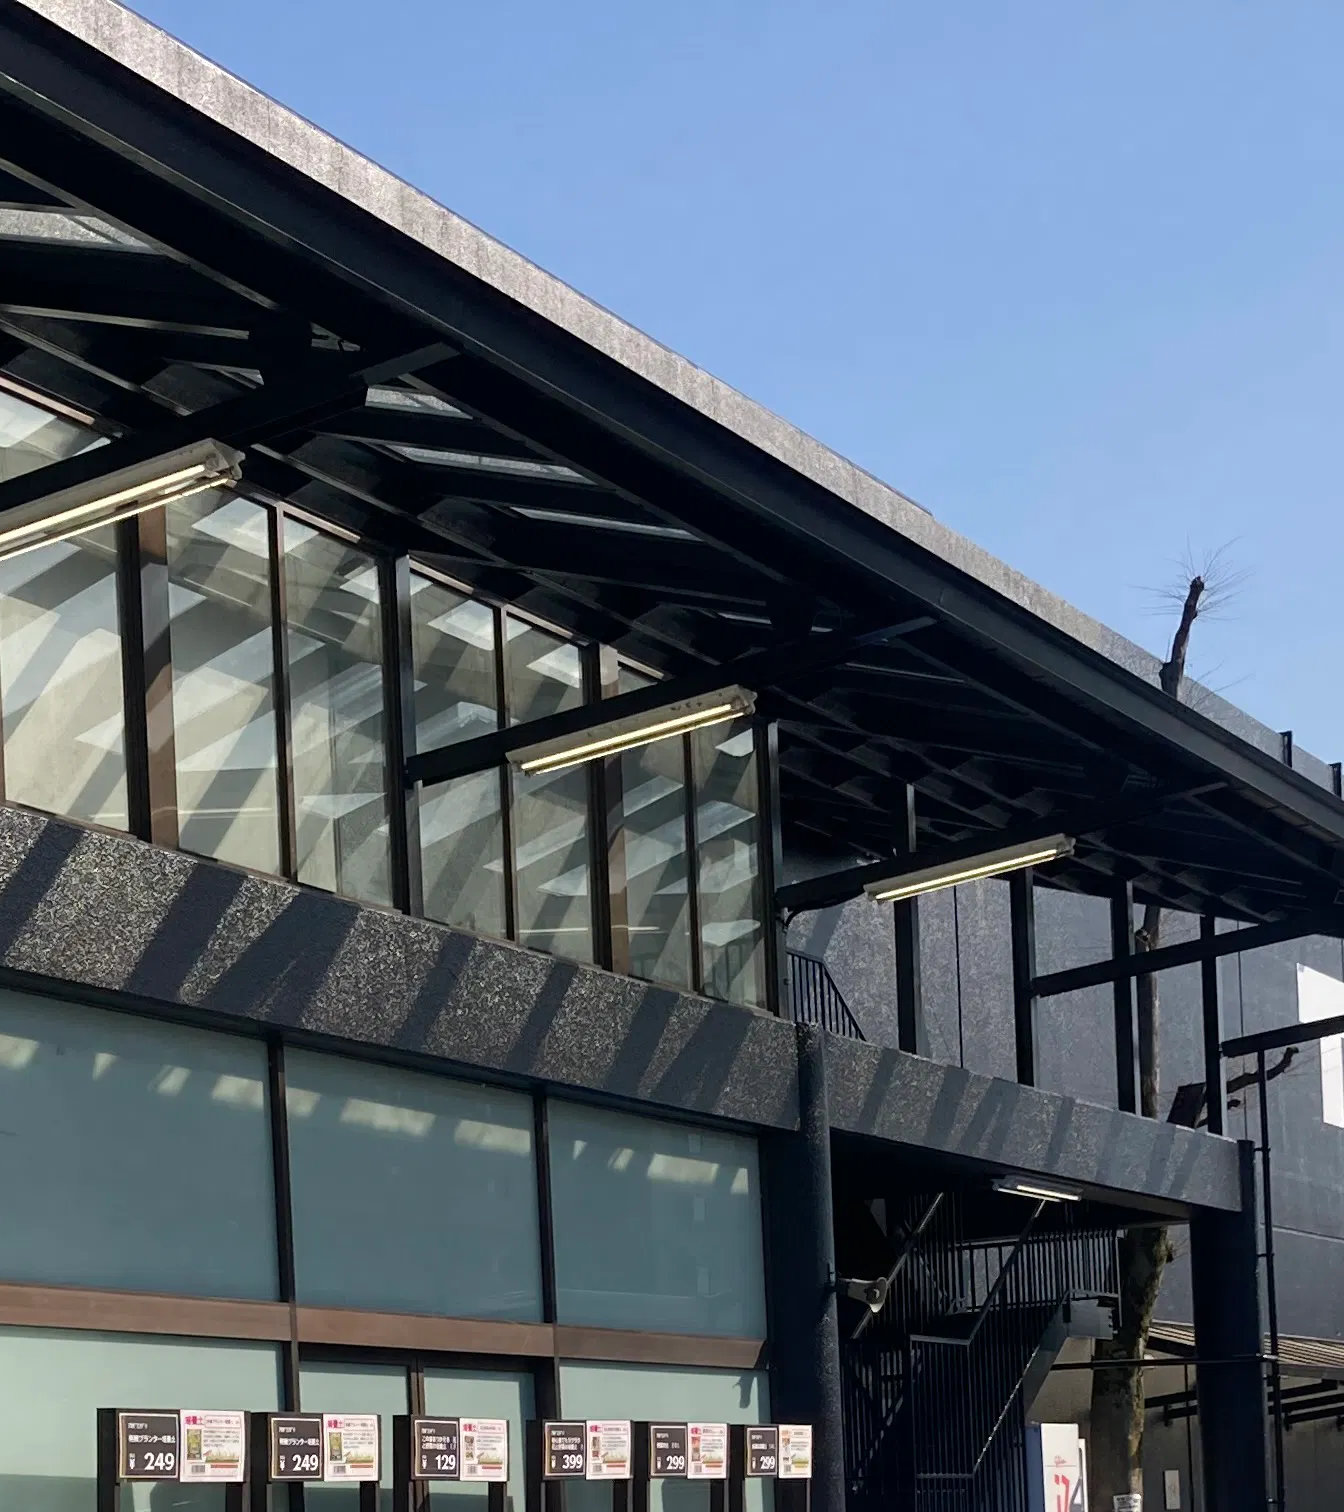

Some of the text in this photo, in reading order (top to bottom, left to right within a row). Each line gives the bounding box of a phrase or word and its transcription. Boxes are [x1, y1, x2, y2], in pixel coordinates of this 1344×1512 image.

[144, 1452, 175, 1471] 249
[292, 1454, 318, 1471] 249
[435, 1455, 456, 1470] 129
[562, 1454, 583, 1469] 399
[666, 1455, 685, 1470] 299
[759, 1455, 776, 1470] 299
